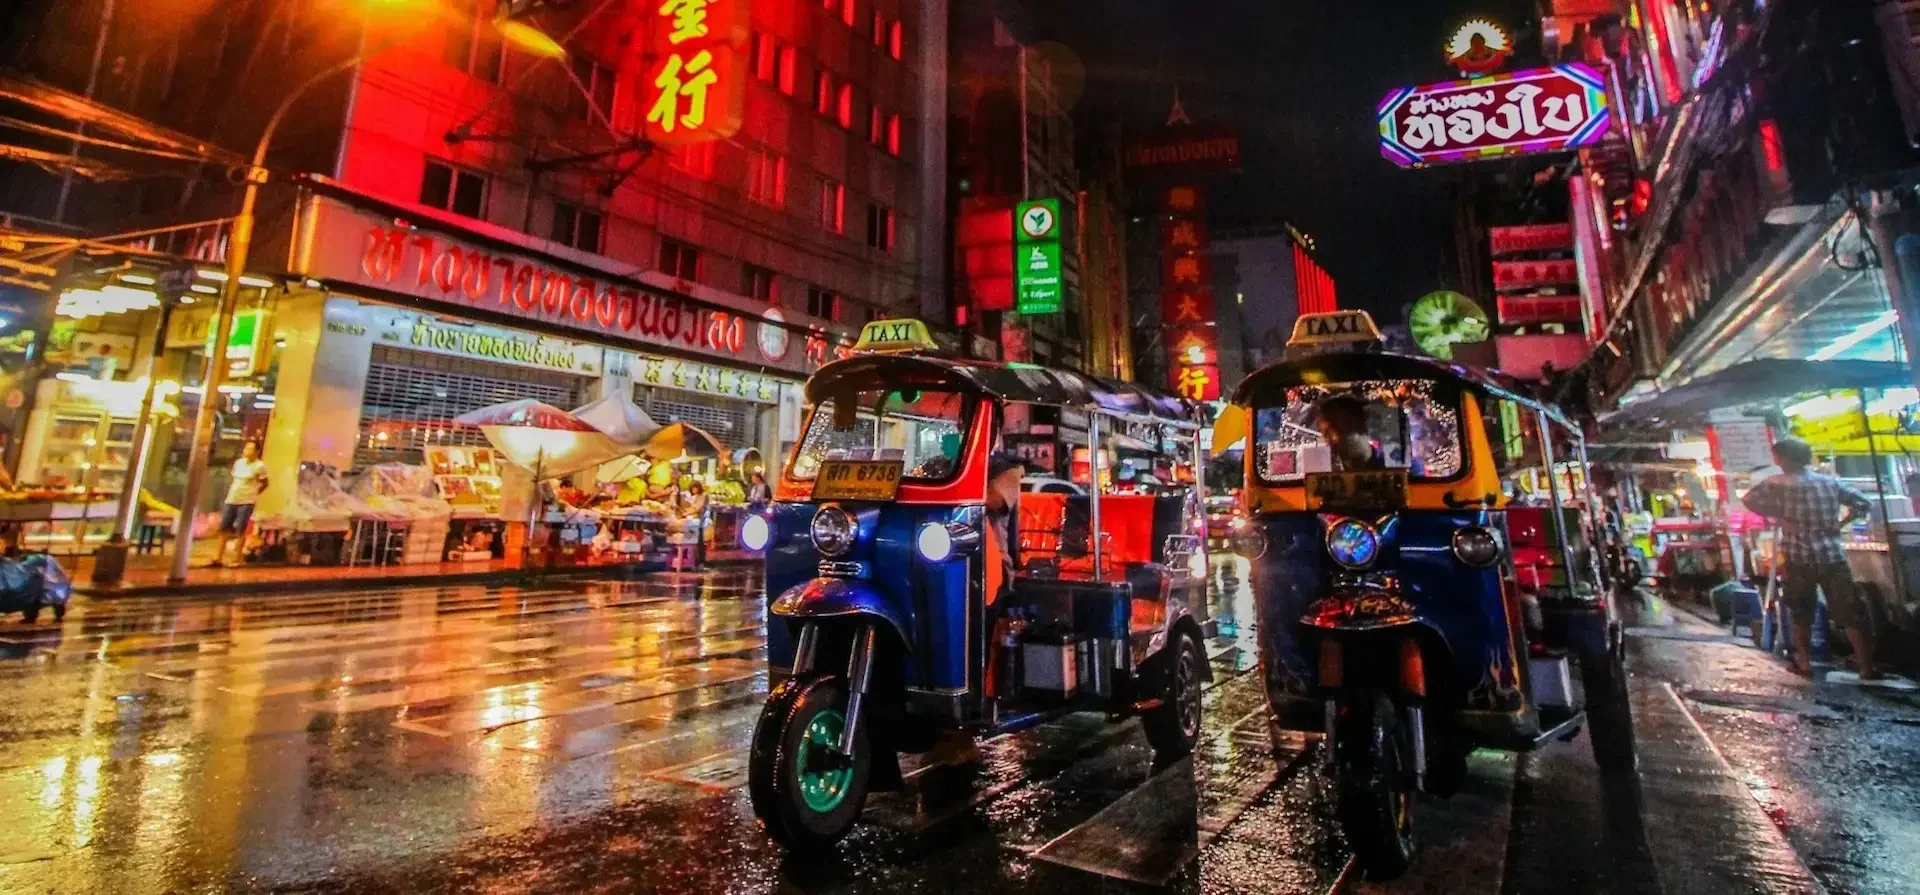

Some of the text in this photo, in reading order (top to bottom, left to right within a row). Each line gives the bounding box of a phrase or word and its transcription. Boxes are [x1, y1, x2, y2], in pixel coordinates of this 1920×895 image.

[647, 0, 718, 133] 金行
[1402, 83, 1584, 149] ทองใบ
[868, 323, 911, 342] TAXI
[1305, 316, 1359, 335] TAXI
[857, 464, 896, 482] 6738
